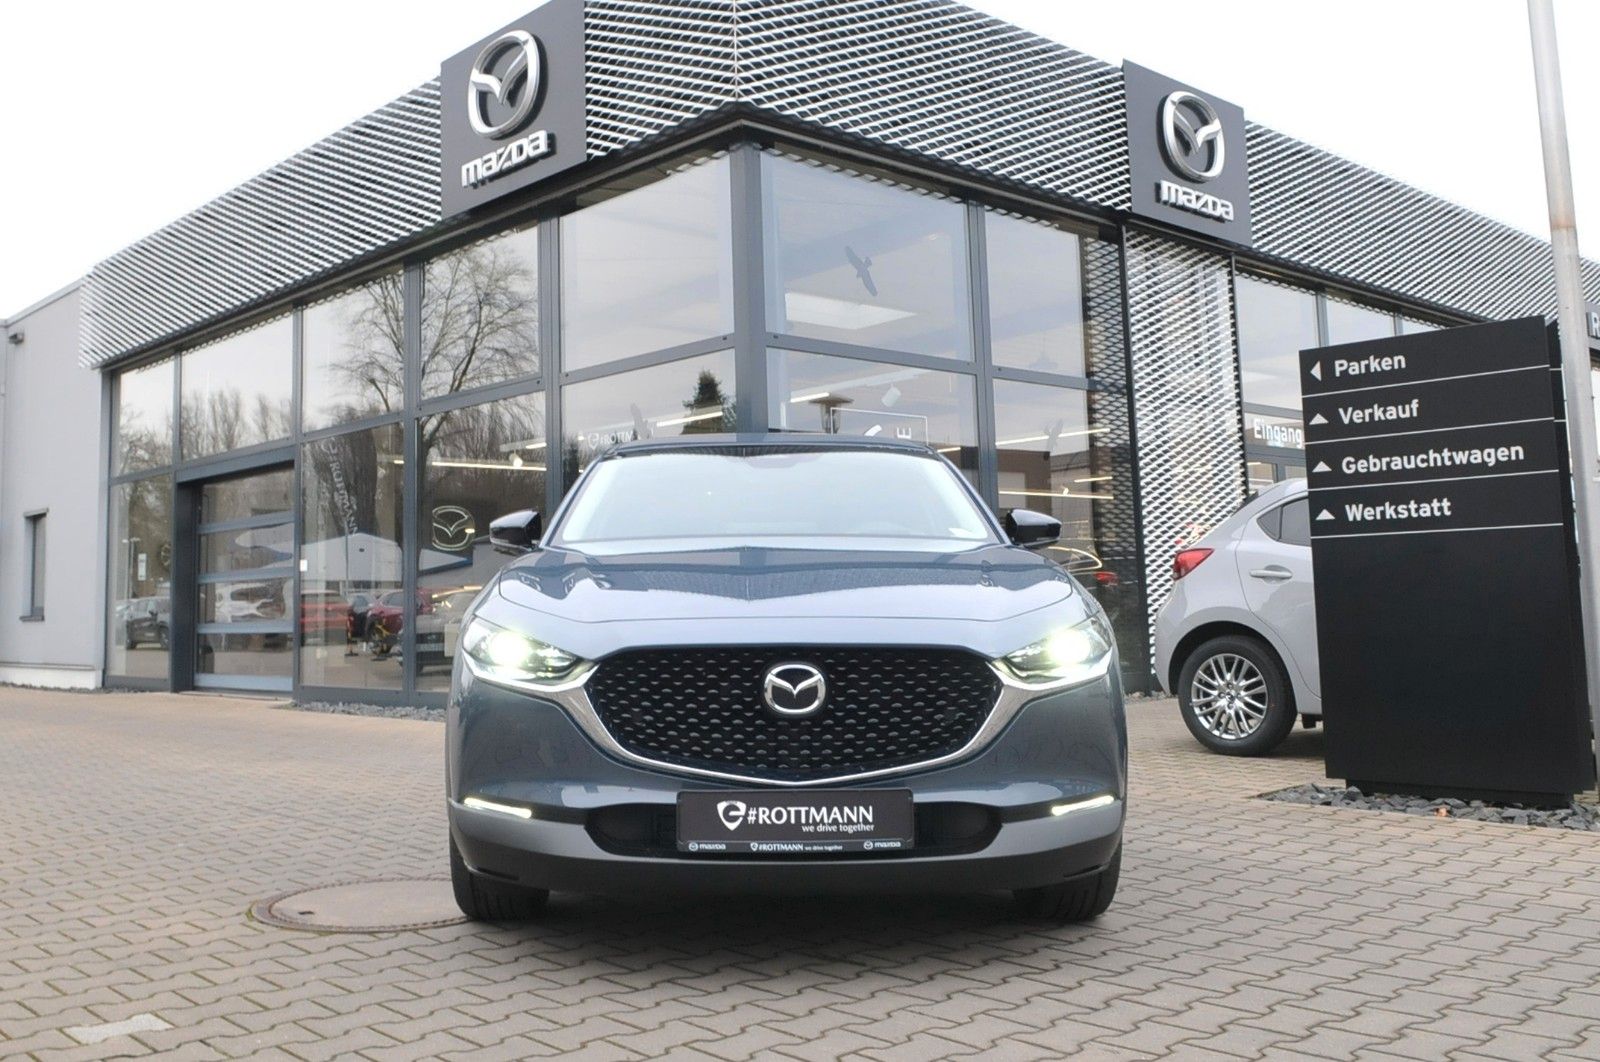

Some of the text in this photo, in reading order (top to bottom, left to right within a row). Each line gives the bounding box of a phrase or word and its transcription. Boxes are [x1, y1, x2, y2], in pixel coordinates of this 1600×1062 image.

[1334, 355, 1407, 377] Parken
[1338, 399, 1420, 425] Verkauf
[1253, 419, 1304, 449] Eingang
[1341, 445, 1525, 474] Gebrauchtwagen
[1345, 498, 1452, 522] Werkstatt
[747, 805, 874, 825] #ROTTMANN
[802, 822, 875, 834] we drive together
